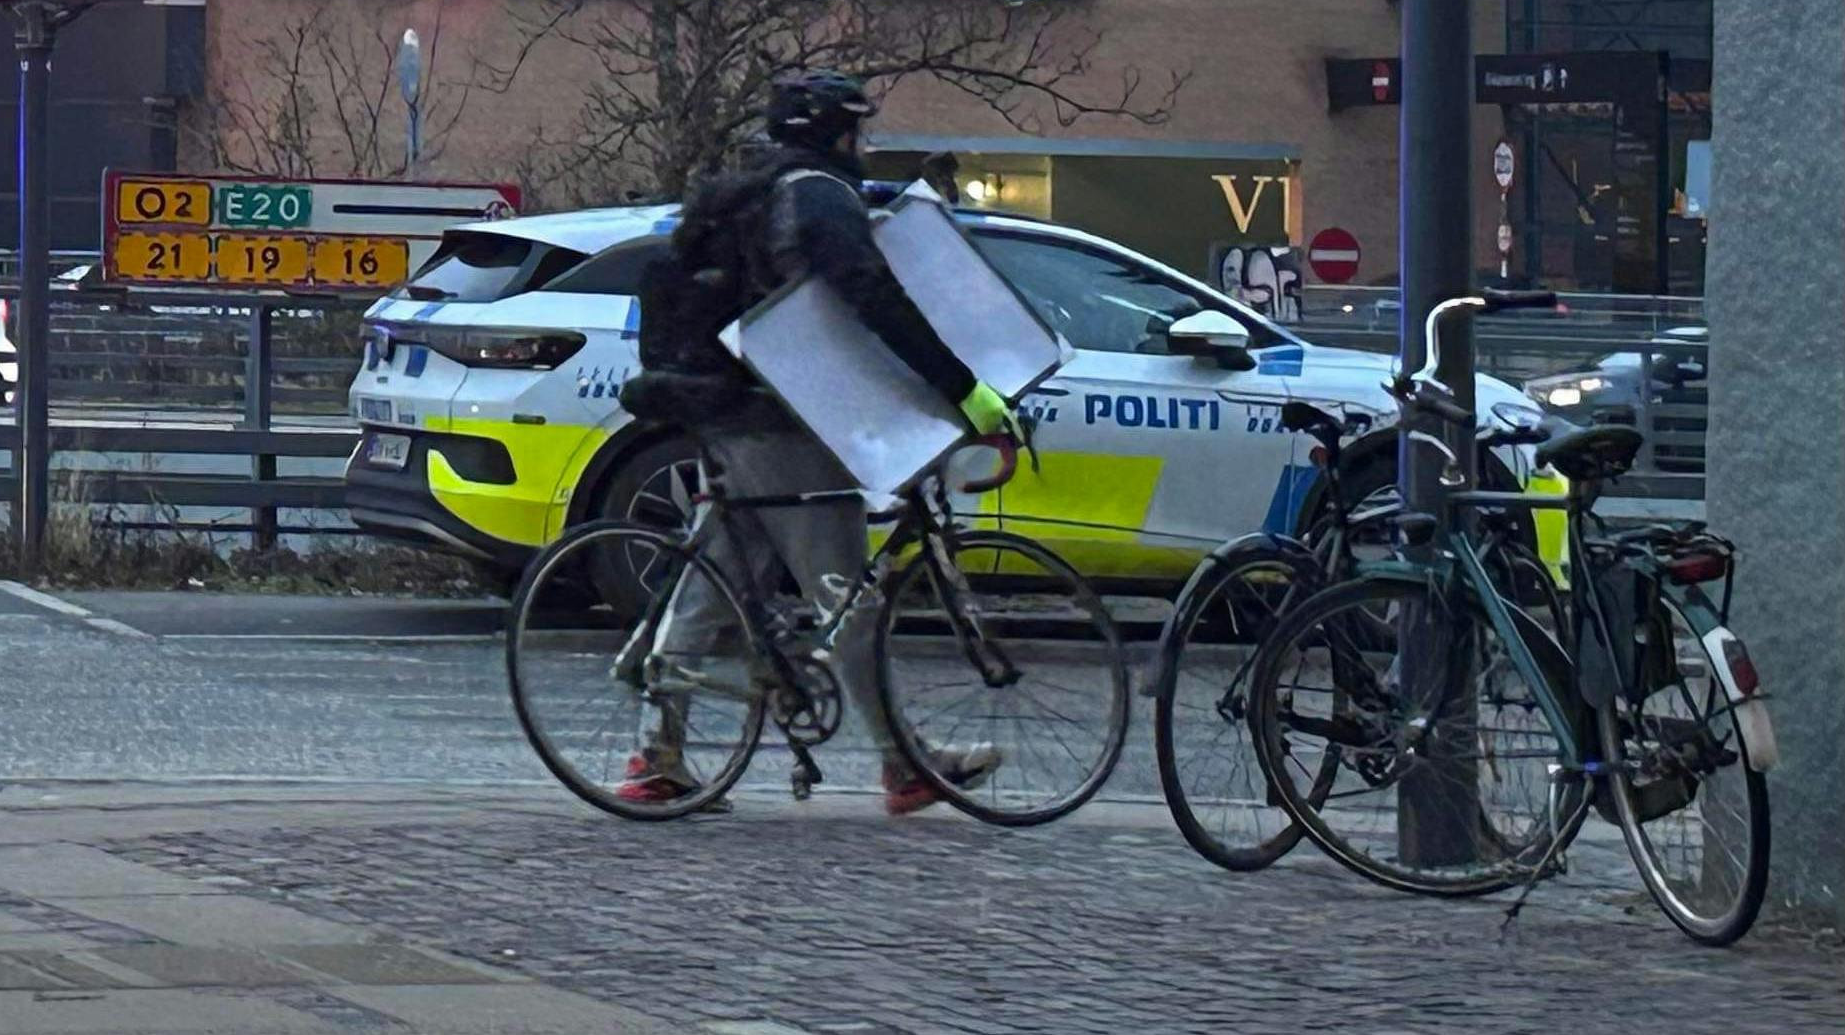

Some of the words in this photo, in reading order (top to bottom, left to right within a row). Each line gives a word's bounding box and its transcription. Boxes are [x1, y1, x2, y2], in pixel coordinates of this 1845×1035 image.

[225, 191, 301, 222] E20
[147, 242, 182, 270] 21
[245, 246, 281, 274] 19
[343, 248, 379, 276] 16
[1084, 393, 1220, 430] POLITI
